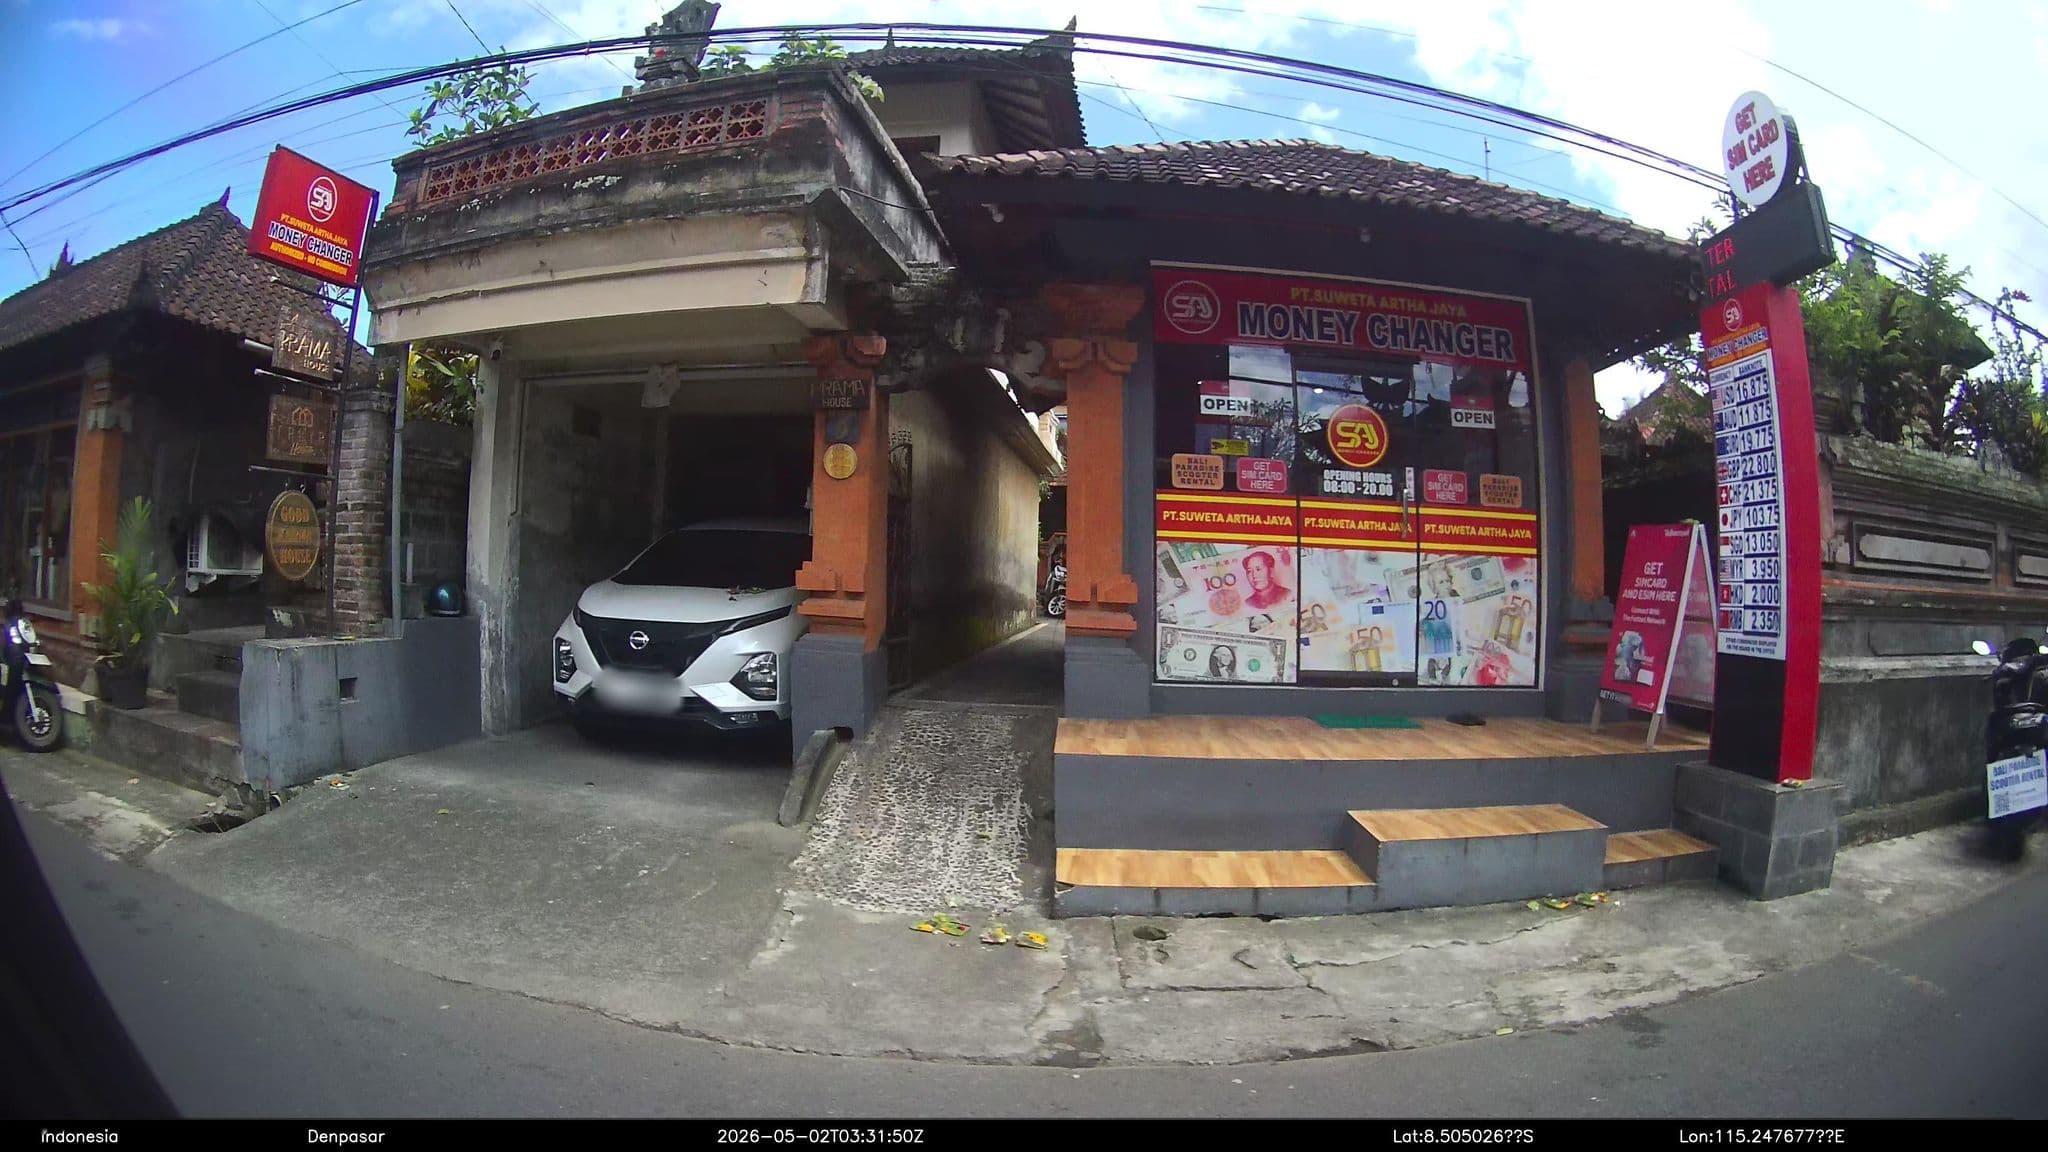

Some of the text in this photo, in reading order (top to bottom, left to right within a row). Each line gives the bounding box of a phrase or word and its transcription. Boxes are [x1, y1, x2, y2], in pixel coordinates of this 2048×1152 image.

[1735, 101, 1758, 134] GET
[1727, 118, 1779, 170] SIM CARD
[1743, 155, 1776, 193] HERE
[268, 221, 353, 266] MONEY CHANGER
[1705, 238, 1735, 268] TER
[1379, 296, 1427, 315] ARTHA
[1429, 302, 1468, 318] JAYA
[1237, 300, 1518, 364] MONEY CHANGER
[1707, 340, 1733, 362] MONEY
[1733, 326, 1769, 352] CHANGER
[822, 397, 852, 408] HOUSE
[1203, 397, 1249, 412] OPEN
[1454, 411, 1494, 425] OPEN
[1254, 461, 1271, 470] GET
[1241, 471, 1282, 481] SIM CARD
[1324, 469, 1393, 484] OPENING HOURS
[1438, 474, 1453, 482] GET
[1251, 480, 1274, 489] HERE
[1324, 480, 1355, 494] 08:00
[1443, 482, 1464, 492] CARD
[1436, 491, 1457, 501] HERE
[1729, 483, 1741, 504] CHF
[1162, 510, 1292, 527] PT.SUWETA ARTHA JAYA
[1304, 517, 1356, 530] PT.SUWETA
[1357, 520, 1386, 531] ARTHA
[1730, 509, 1742, 528] JPY
[1424, 523, 1532, 539] PT.SUWETA ARTHA JAYA
[1730, 534, 1743, 554] SGD
[1643, 562, 1664, 575] GET
[1204, 573, 1236, 592] 100
[1635, 576, 1668, 589] SIMCARD
[1623, 589, 1639, 600] AND
[1656, 590, 1676, 602] HERE
[1424, 600, 1447, 621] 20
[1357, 626, 1383, 643] 50
